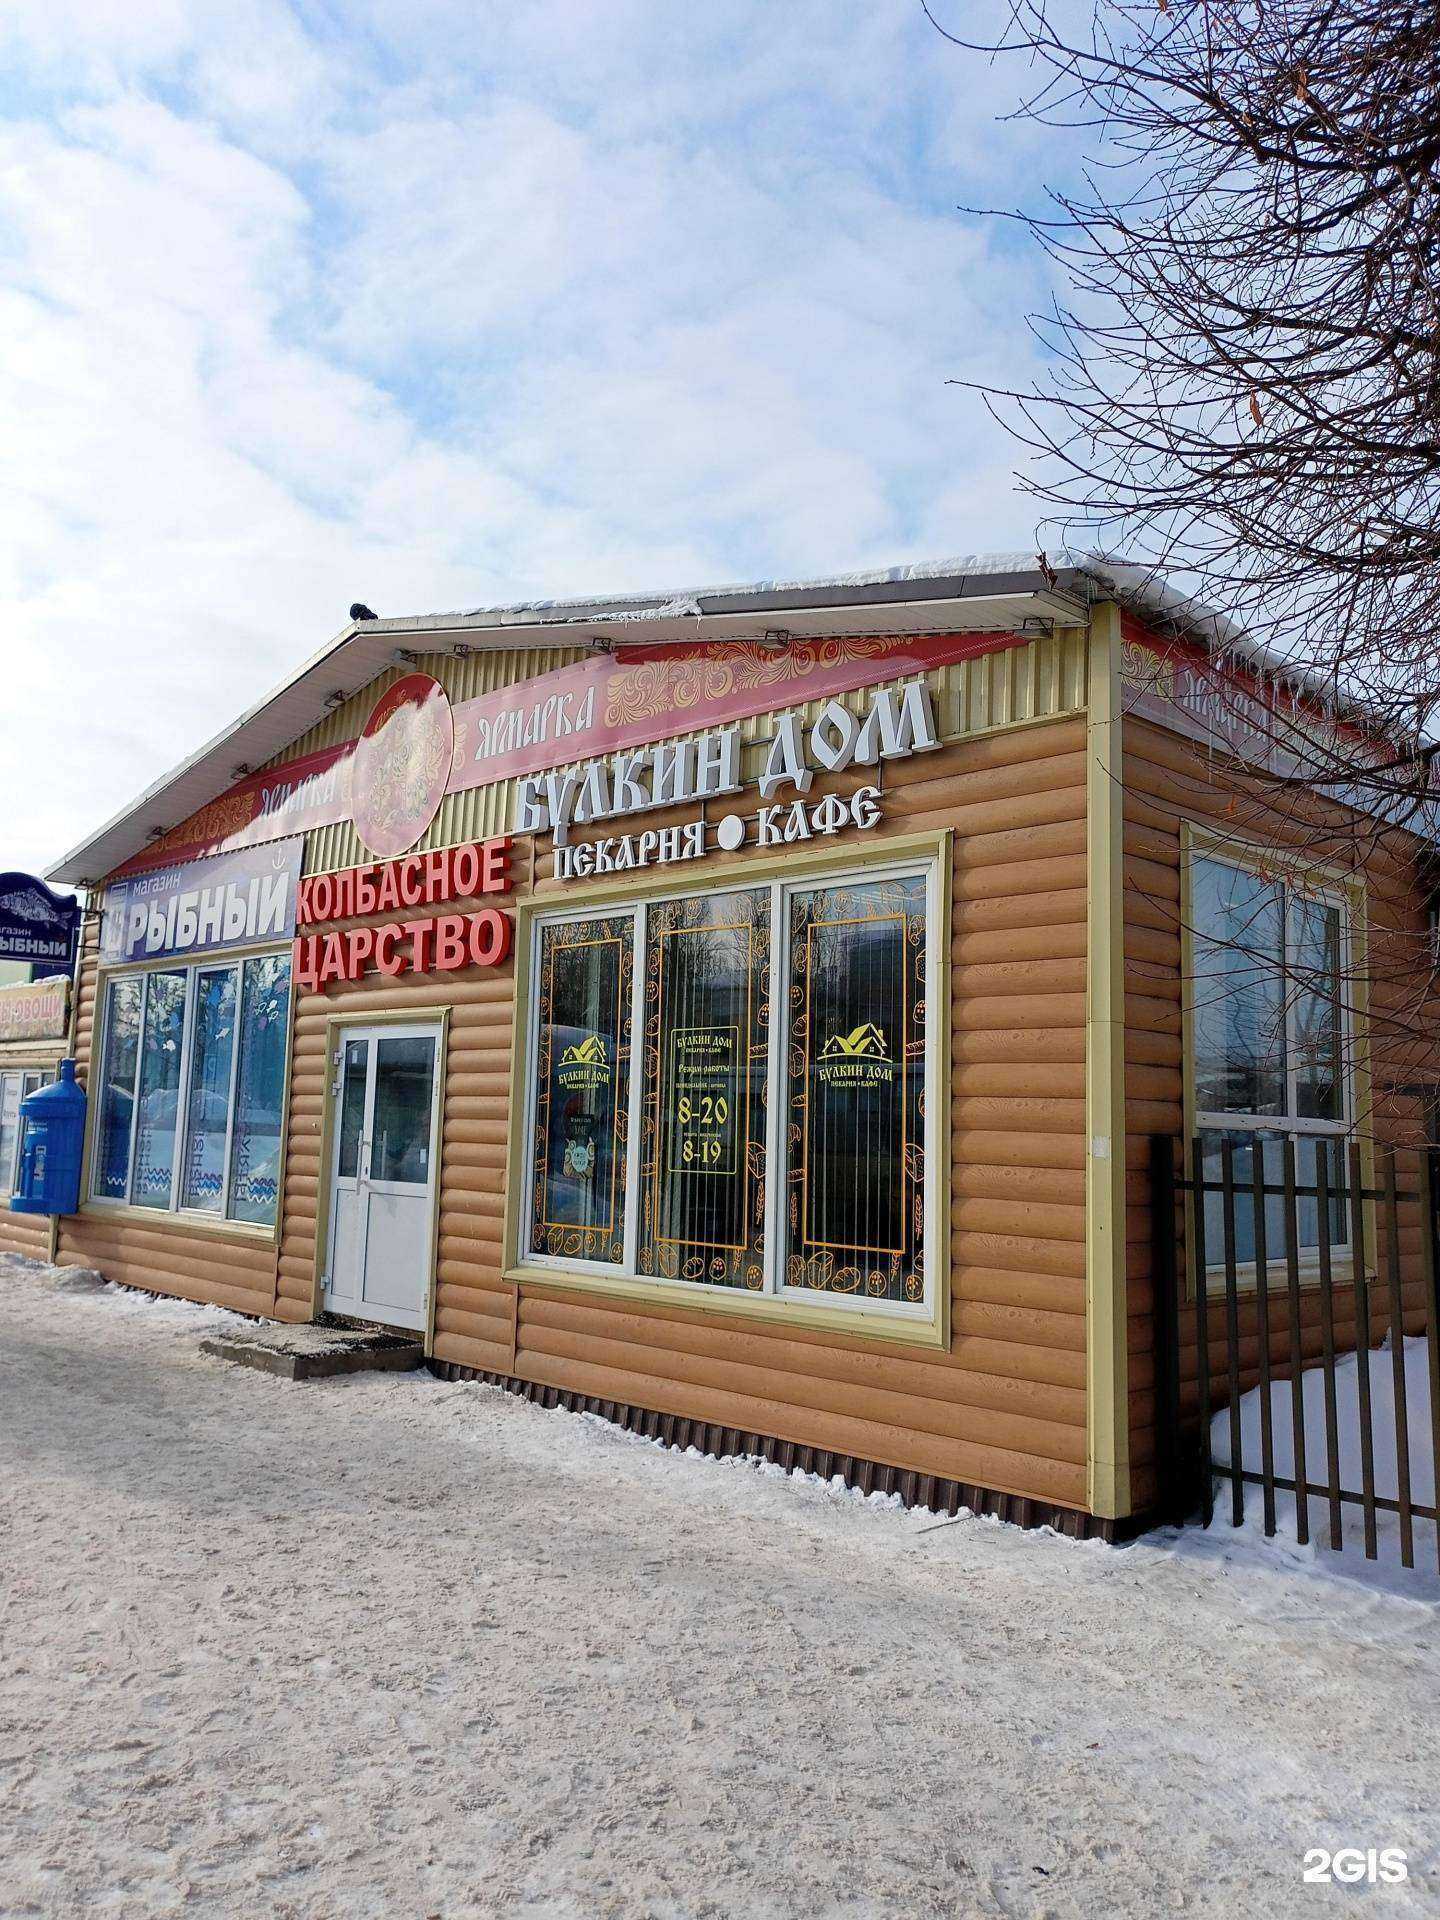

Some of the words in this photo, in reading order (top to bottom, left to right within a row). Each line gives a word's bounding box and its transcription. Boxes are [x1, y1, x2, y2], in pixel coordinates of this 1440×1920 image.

[475, 685, 595, 761] ЯРМАРКА
[513, 728, 744, 846] БУЛКИН
[758, 679, 943, 800] ДОМ
[552, 820, 706, 880] ПЕКАРНЯ
[756, 786, 884, 847] КАФЕ
[126, 871, 290, 956] РЫБНЫЙ
[132, 872, 182, 897] магазин
[296, 836, 513, 925] КОЛБАСНОЕ
[0, 926, 32, 937] газин
[292, 909, 511, 993] ЦАРСТВО
[678, 1096, 729, 1124] 8-20
[819, 1065, 863, 1082] БУЛКИН
[866, 1064, 893, 1081] ДОМ
[683, 1140, 721, 1164] 8-19
